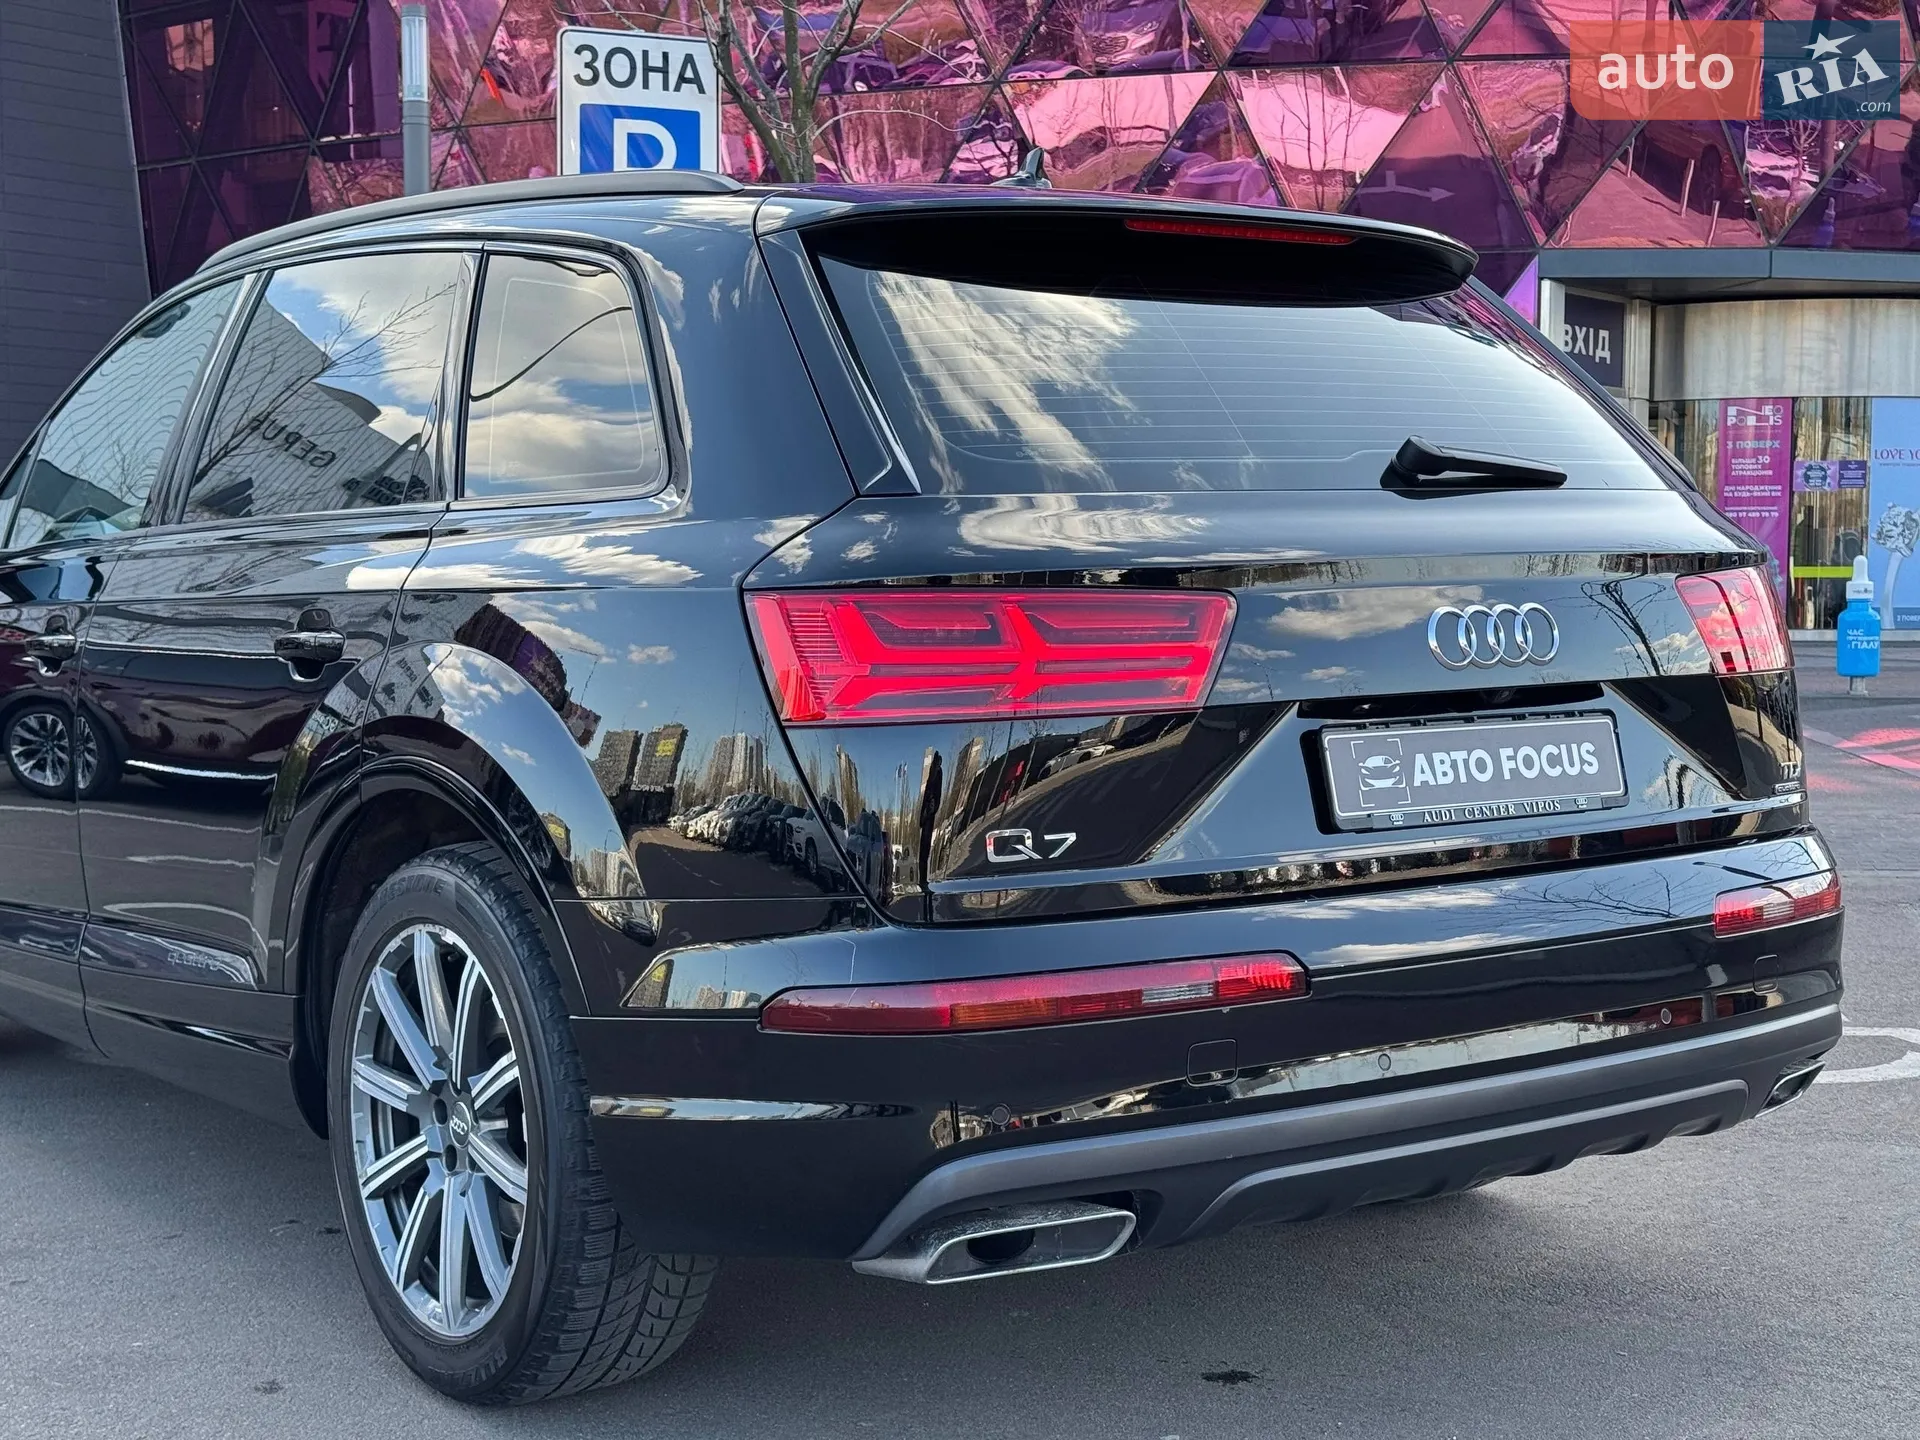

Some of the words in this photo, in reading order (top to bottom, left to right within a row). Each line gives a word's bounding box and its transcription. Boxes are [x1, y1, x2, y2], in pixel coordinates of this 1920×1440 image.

[573, 44, 706, 94] ЗОНА
[1564, 323, 1611, 364] ВХІД
[1736, 440, 1780, 449] ПОВЕРХ
[1874, 448, 1905, 460] LOVE
[1757, 455, 1770, 464] 30
[1413, 748, 1494, 787] АВТО
[1499, 742, 1599, 780] FOCUS
[1422, 810, 1456, 823] AUDI
[1463, 803, 1516, 819] CENTER
[1522, 799, 1561, 813] VIPOS
[986, 829, 1076, 862] Q7
